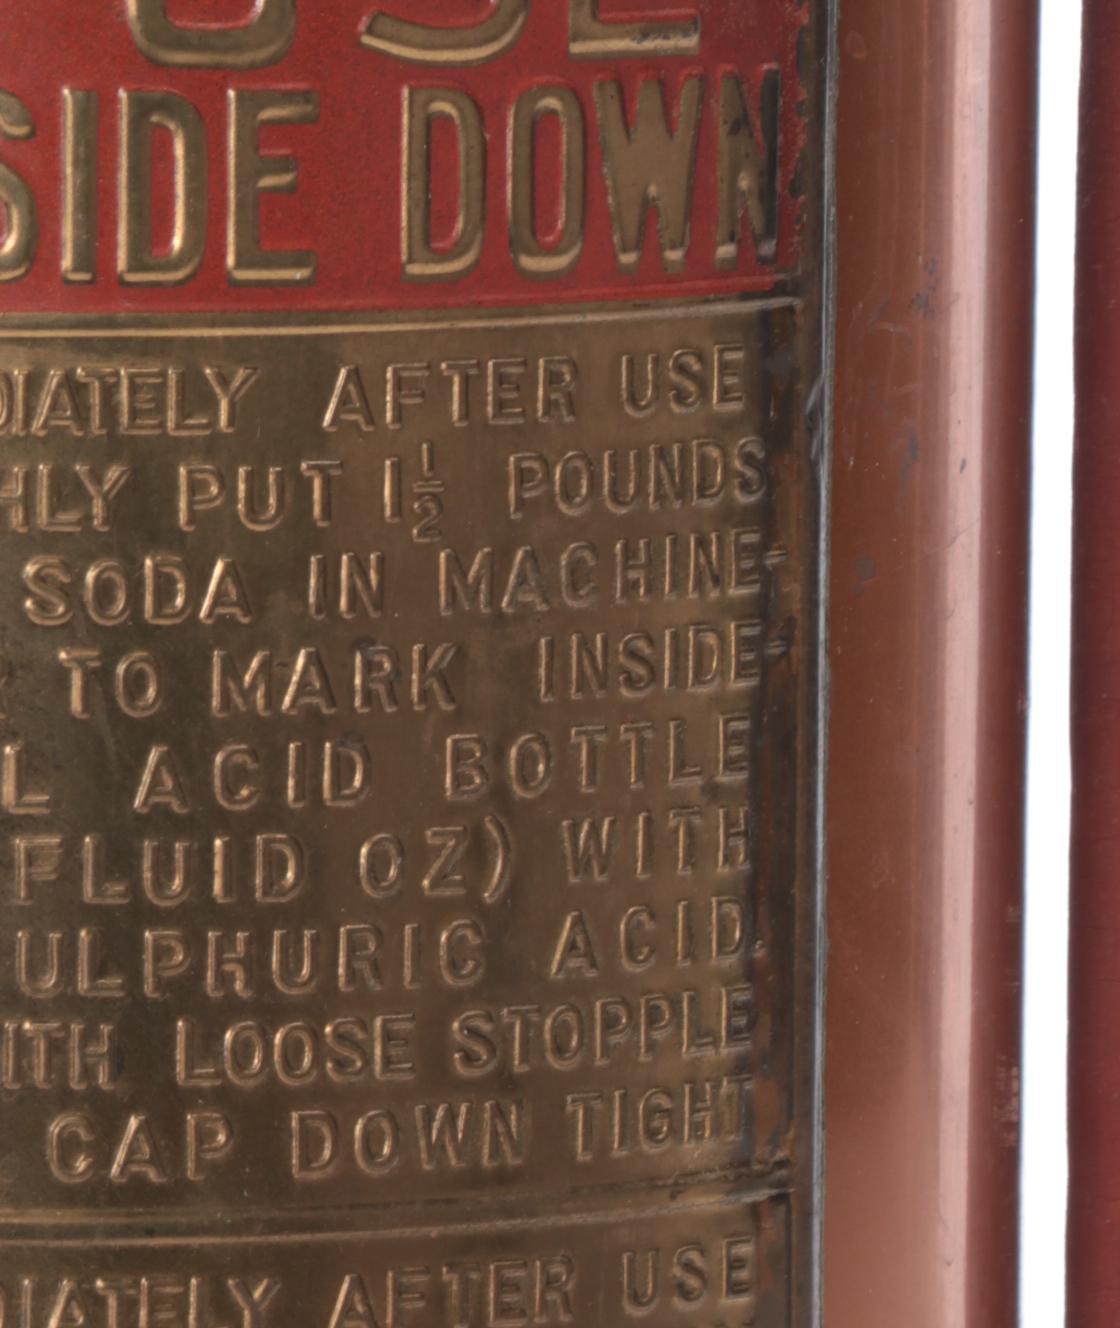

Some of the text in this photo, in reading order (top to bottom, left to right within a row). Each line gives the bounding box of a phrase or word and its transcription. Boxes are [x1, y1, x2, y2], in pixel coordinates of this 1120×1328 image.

[401, 62, 779, 276] DOWN
[322, 356, 576, 432] AFTER
[619, 343, 745, 418] USE
[180, 460, 344, 531] PUT
[508, 436, 767, 519] POUNDS
[22, 554, 253, 626] SODA
[308, 551, 381, 619] IN
[58, 646, 162, 718] TO
[209, 640, 459, 715] MARK
[133, 741, 372, 813] ACID
[445, 712, 750, 801] BOTTLE
[12, 832, 304, 905] FLUID
[359, 815, 514, 904] OZ)
[561, 806, 751, 882] WITH
[176, 1011, 416, 1087] LOOSE
[453, 982, 754, 1074] STOPPLE
[47, 1109, 234, 1183] CAP
[291, 1099, 525, 1182] DOWN
[566, 1074, 755, 1163] TIGHT
[621, 1234, 755, 1315] USE
